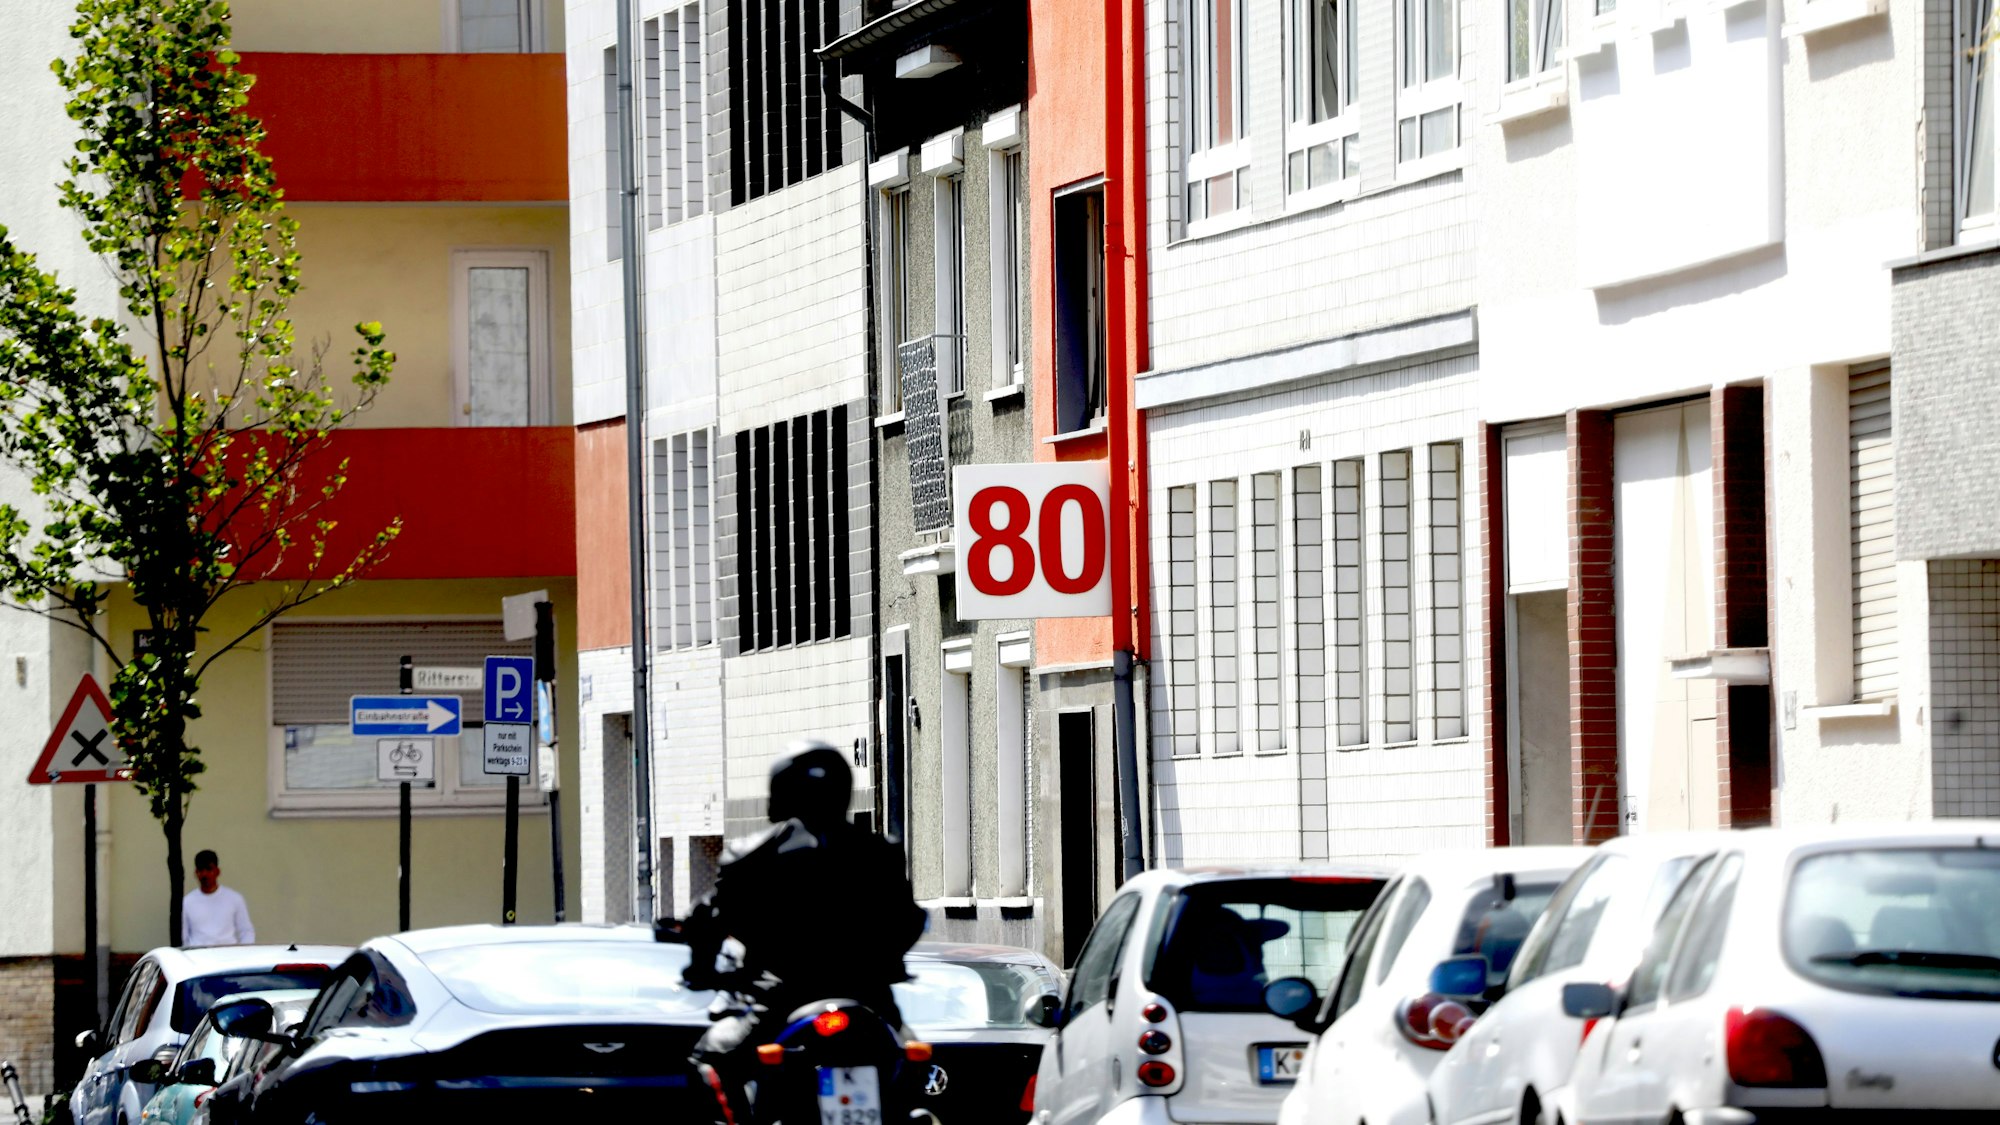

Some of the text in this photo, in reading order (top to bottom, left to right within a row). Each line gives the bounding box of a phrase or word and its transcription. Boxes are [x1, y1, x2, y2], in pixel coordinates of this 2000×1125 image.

[967, 483, 1106, 597] 80
[495, 666, 522, 719] P
[357, 710, 430, 722] Einbahnstraße
[498, 731, 517, 740] nur mit
[493, 743, 522, 752] Parkschein
[487, 756, 510, 767] werktags
[1275, 1051, 1290, 1074] K
